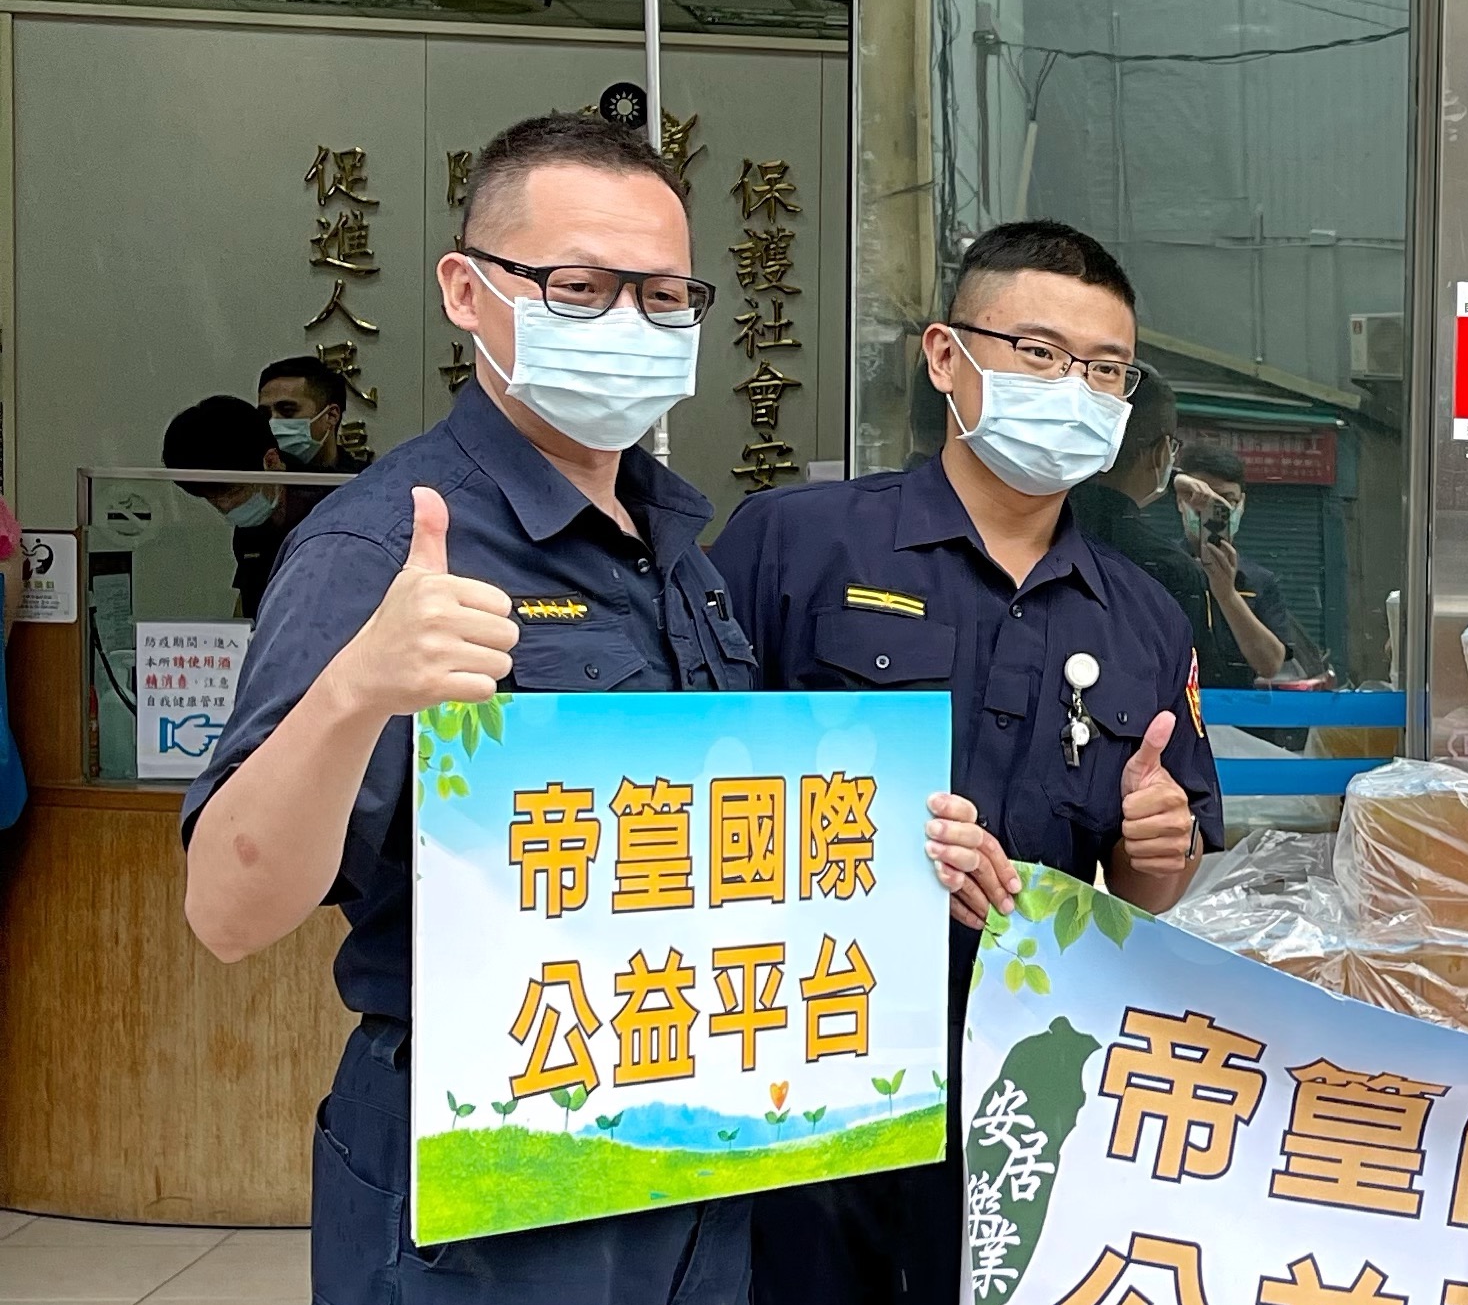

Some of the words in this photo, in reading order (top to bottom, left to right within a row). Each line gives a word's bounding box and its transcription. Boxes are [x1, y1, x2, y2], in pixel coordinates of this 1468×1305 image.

[729, 158, 802, 494] 保護社會安
[508, 771, 878, 918] 帝篁國際
[508, 933, 878, 1101] 公益平台
[967, 1078, 1056, 1300] 安居樂業
